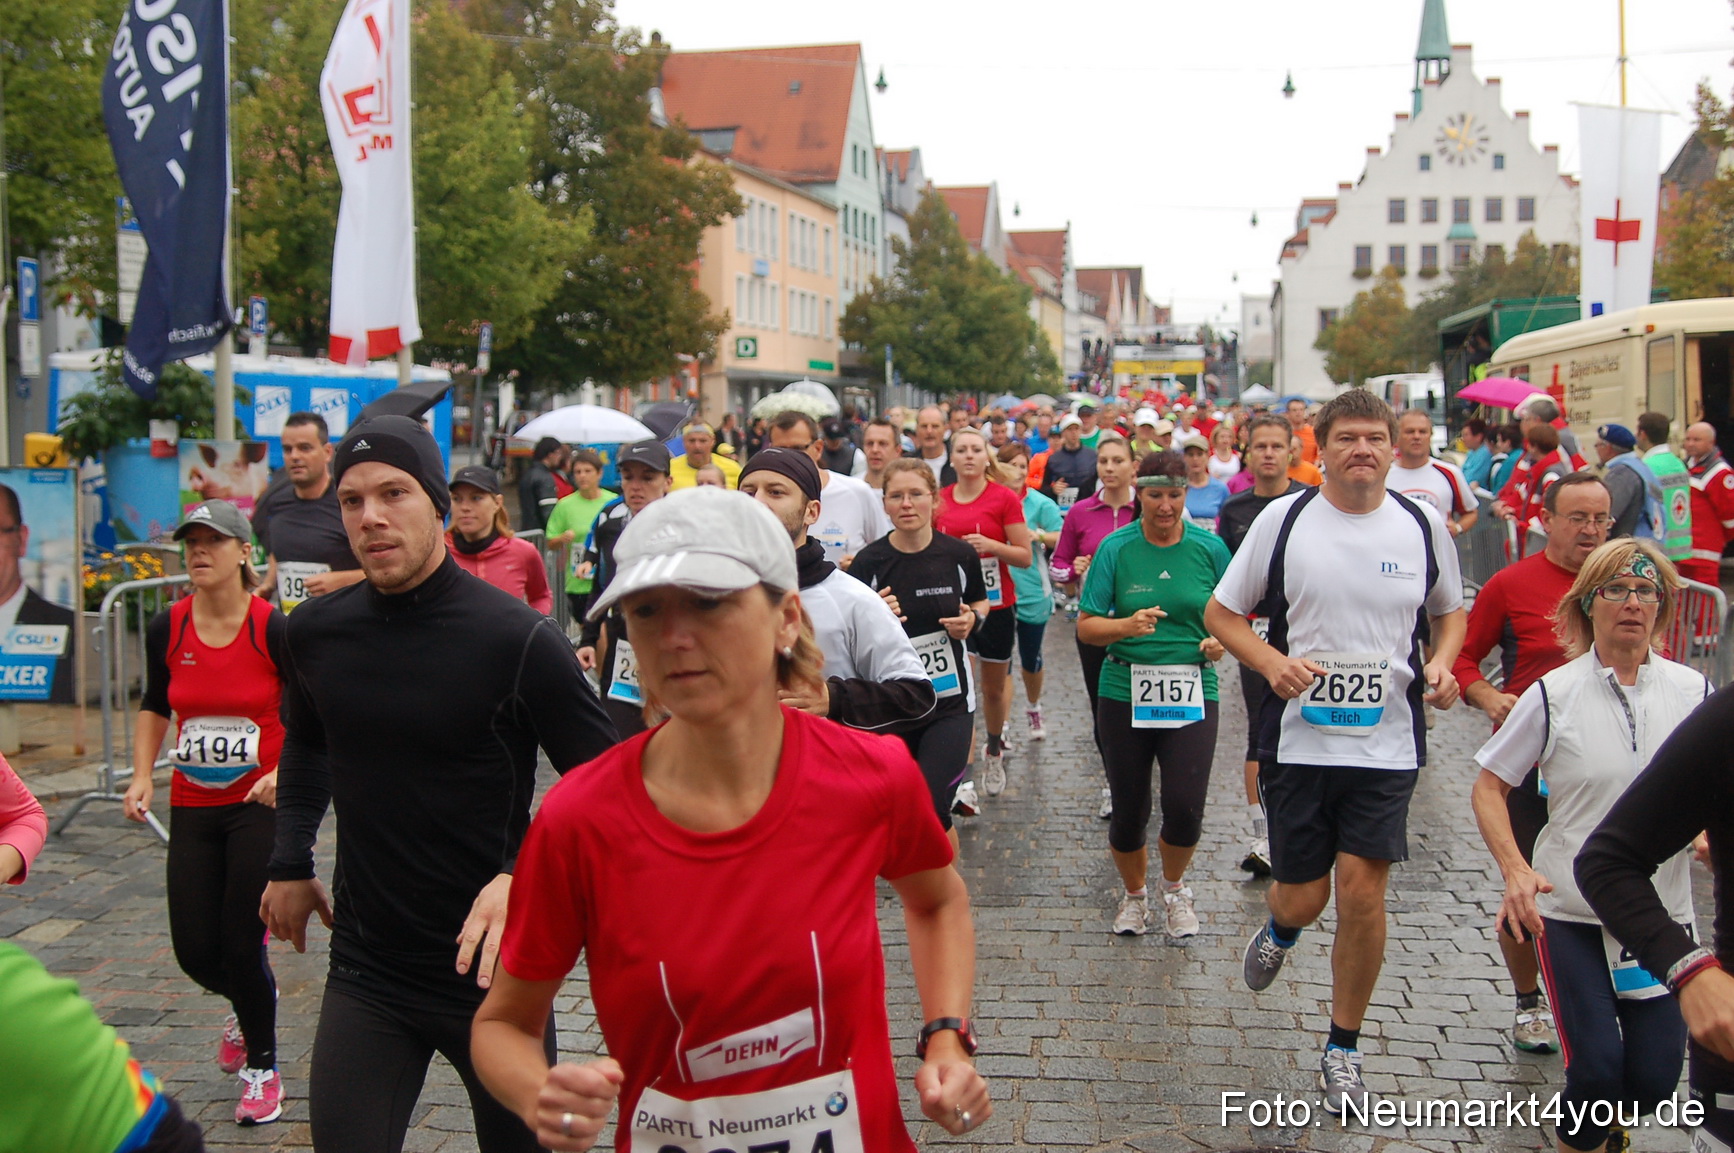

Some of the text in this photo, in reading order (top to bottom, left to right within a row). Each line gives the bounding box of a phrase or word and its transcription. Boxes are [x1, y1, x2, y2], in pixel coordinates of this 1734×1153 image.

[16, 633, 44, 645] CSU
[1333, 661, 1376, 669] Neumarkt
[1140, 680, 1195, 702] 2157
[1309, 673, 1383, 703] 2625
[1151, 709, 1185, 718] Martina
[1331, 711, 1360, 723] Erich
[200, 724, 242, 733] Neumarkt
[725, 1035, 779, 1065] DEHN
[636, 1104, 816, 1139] PARTL Neumarkt
